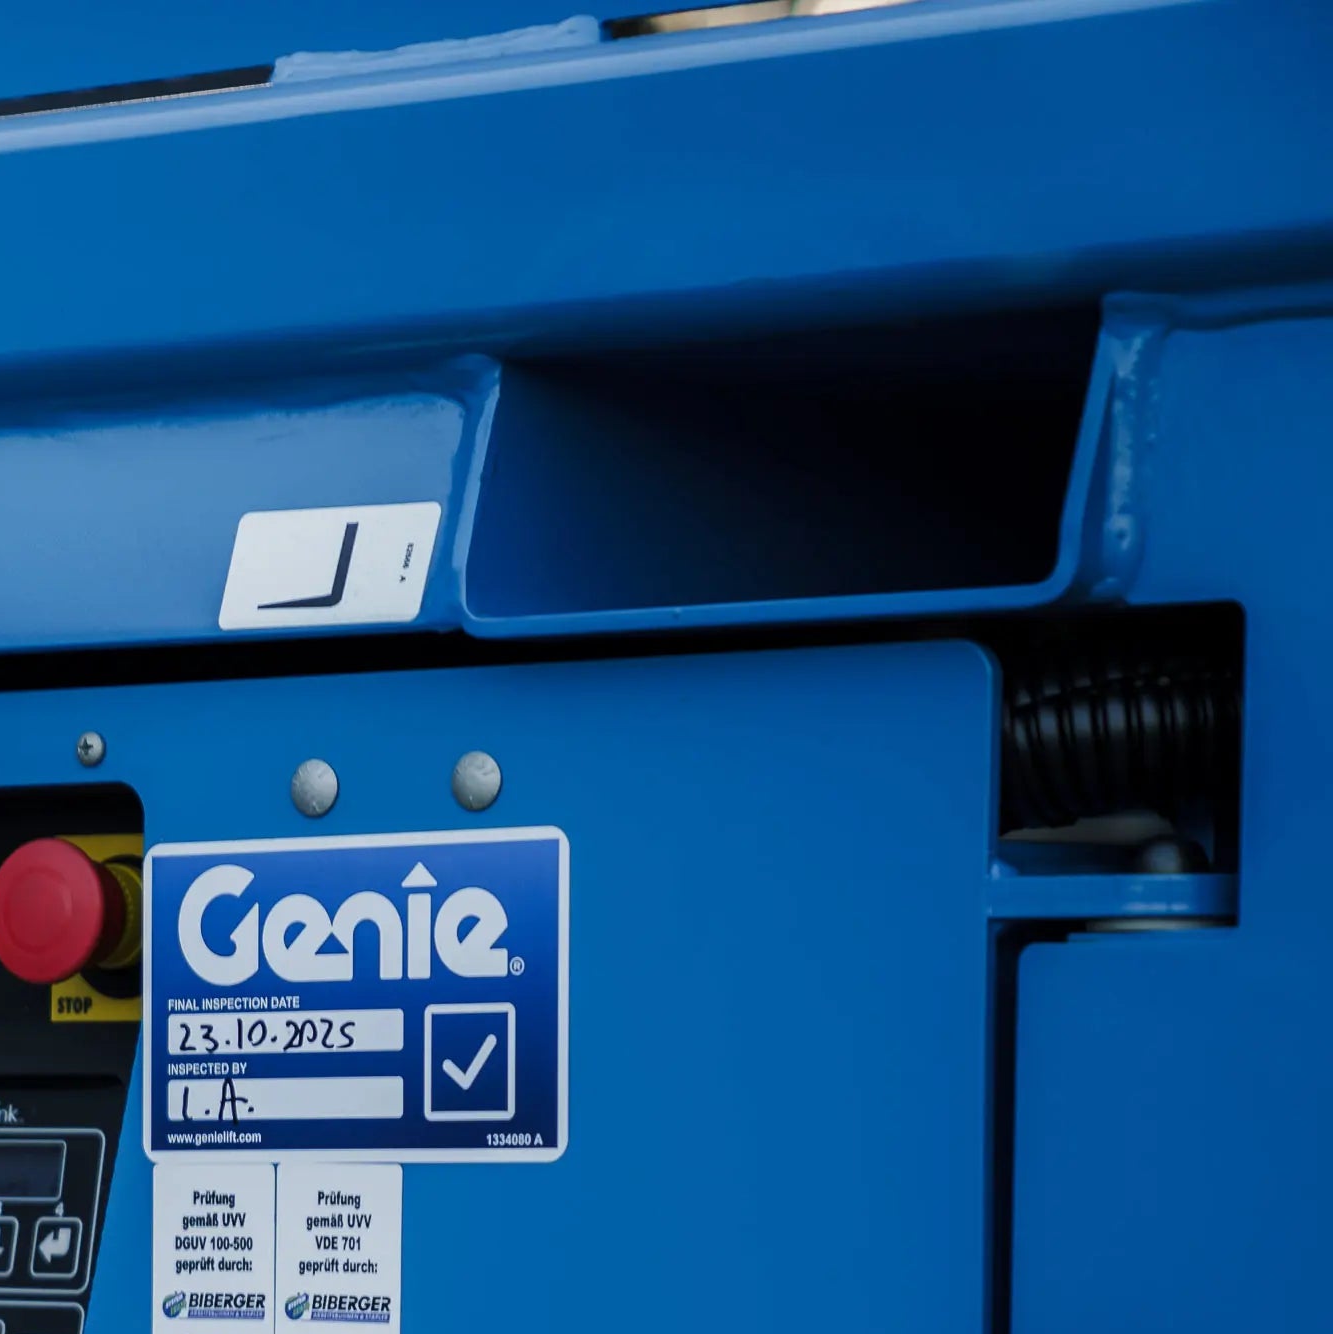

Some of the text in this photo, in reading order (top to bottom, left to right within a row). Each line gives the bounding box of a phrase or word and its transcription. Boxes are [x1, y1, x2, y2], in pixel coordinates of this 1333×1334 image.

[178, 861, 509, 987] Genie
[57, 997, 93, 1014] STOP
[168, 995, 300, 1011] FINAL INSPECTION DATE
[168, 1062, 247, 1075] INSPECTED BY
[167, 1131, 262, 1146] www.genielift.com
[486, 1133, 543, 1146] 1334080 A
[193, 1190, 235, 1208] Prüfung
[317, 1190, 361, 1209] Prüfung
[54, 1202, 64, 1217] 4
[182, 1212, 246, 1230] gemäß UVV
[306, 1213, 372, 1231] gemäß UVV
[175, 1236, 253, 1250] DGUV 100-500
[315, 1235, 361, 1251] VDE 701
[175, 1256, 253, 1274] geprüft durch:
[299, 1258, 378, 1275] geprüft durch:
[188, 1292, 266, 1309] BIBERGER
[312, 1294, 391, 1312] BIBERGER
